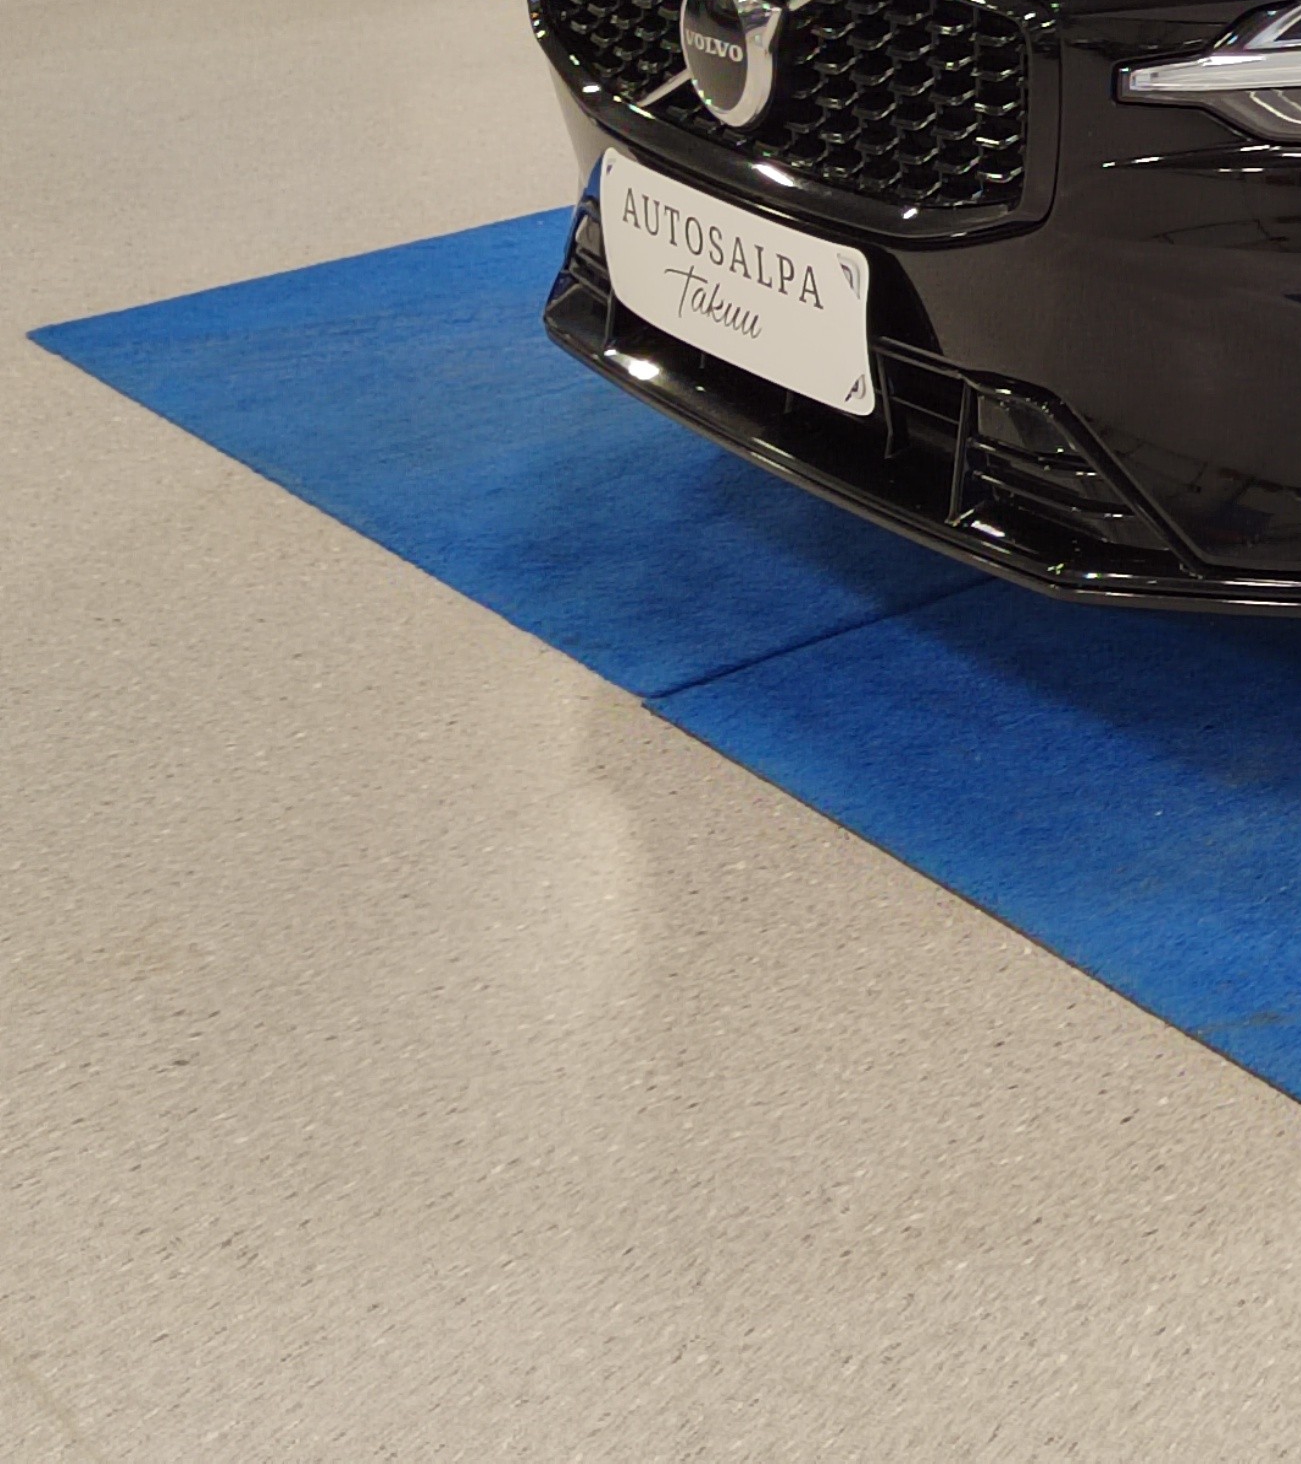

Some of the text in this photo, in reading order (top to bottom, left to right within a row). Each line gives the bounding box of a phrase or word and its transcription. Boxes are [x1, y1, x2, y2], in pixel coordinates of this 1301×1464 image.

[685, 27, 744, 63] VOLVO
[622, 187, 825, 310] AUTOSALPA
[664, 265, 763, 339] Takuu
